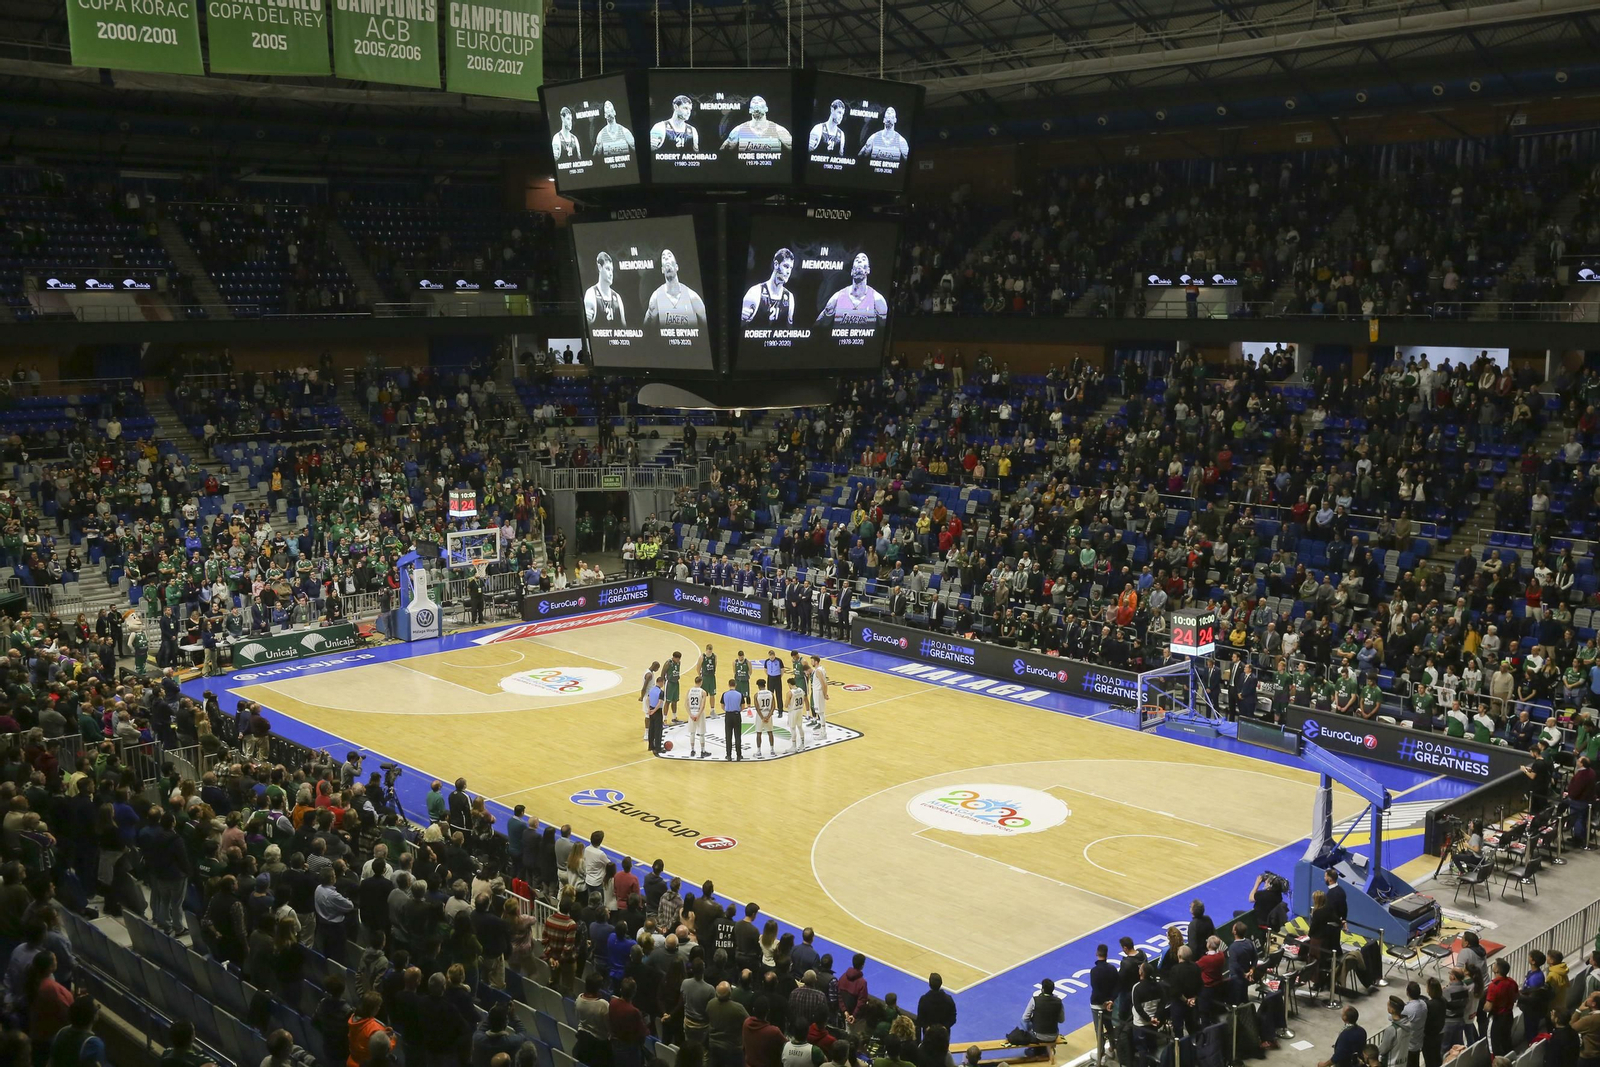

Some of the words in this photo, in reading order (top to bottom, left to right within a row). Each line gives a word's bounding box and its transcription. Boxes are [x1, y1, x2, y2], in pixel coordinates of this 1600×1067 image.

[209, 2, 254, 20] COPA
[257, 7, 289, 24] DEL
[293, 11, 323, 28] REY
[450, 3, 540, 39] CAMPEONES
[97, 22, 178, 45] 2000/2001
[366, 17, 410, 41] ACB
[251, 32, 288, 50] 2005
[456, 30, 534, 56] EUROCUP
[354, 39, 421, 61] 2005/2006
[466, 55, 524, 75] 2016/2017
[716, 92, 724, 100] IN
[700, 102, 741, 110] MEMORIAM
[617, 208, 648, 220] MONDO
[815, 208, 852, 220] MONDO
[630, 247, 638, 256] IN
[820, 247, 829, 256] IN
[619, 259, 654, 270] MEMORIAM
[801, 259, 844, 270] MEMORIAM
[769, 308, 780, 320] 21
[592, 329, 613, 337] ROBERT
[613, 329, 643, 337] ARCHIBALD
[660, 328, 675, 337] KOBE
[676, 328, 699, 337] BRYANT
[744, 329, 772, 338] ROBERT
[773, 329, 811, 338] ARCHIBALD
[831, 328, 848, 337] KOBE
[849, 328, 875, 337] BRYANT
[450, 499, 459, 510] 24
[461, 499, 474, 511] 24
[608, 590, 648, 604] GREATNESS
[682, 592, 703, 604] EuroCup
[550, 600, 577, 609] EuroCup
[726, 604, 761, 619] GREATNESS
[1173, 615, 1197, 626] 10:00
[1199, 614, 1215, 626] 10:00
[324, 635, 355, 649] Unicaja
[873, 633, 899, 646] EuroCup
[1173, 627, 1193, 646] 24
[1199, 626, 1213, 646] 24
[265, 646, 298, 659] Unicaja
[929, 648, 975, 665] GREATNESS
[232, 653, 375, 680] @unicajaCB
[1026, 664, 1057, 680] EuroCup
[888, 662, 1051, 701] MALAGA
[690, 696, 699, 706] 23
[761, 698, 770, 708] 10
[794, 697, 803, 707] 30
[1321, 727, 1363, 745] EuroCup
[1415, 751, 1489, 776] GREATNESS
[937, 790, 1031, 828] 2020
[607, 801, 700, 838] EuroCup
[706, 841, 734, 849] DAYS
[717, 923, 735, 933] CITY
